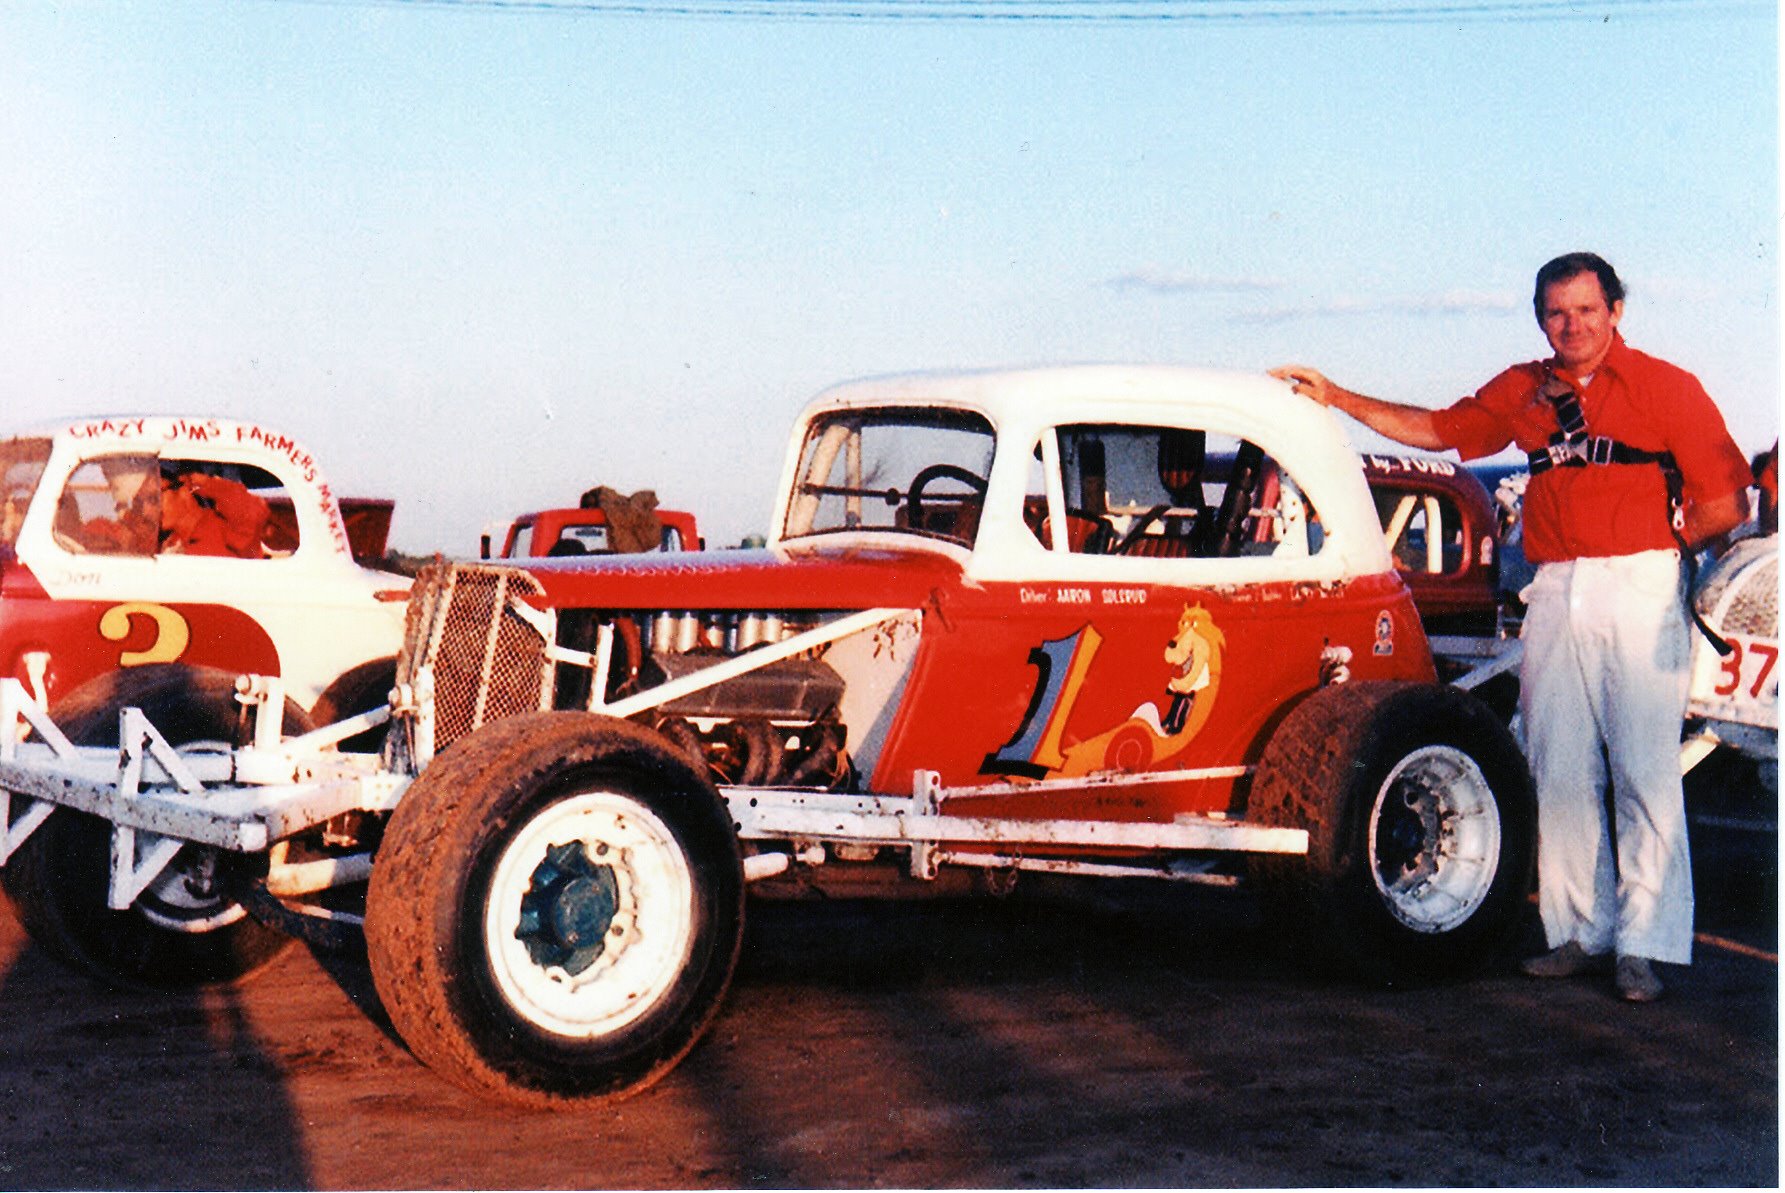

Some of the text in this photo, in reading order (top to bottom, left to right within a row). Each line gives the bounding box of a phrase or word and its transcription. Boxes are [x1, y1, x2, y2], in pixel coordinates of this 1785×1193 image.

[69, 419, 146, 439] CRAZY
[236, 426, 318, 483] FARMERS
[318, 484, 346, 554] MARKET
[1714, 637, 1779, 699] 37
